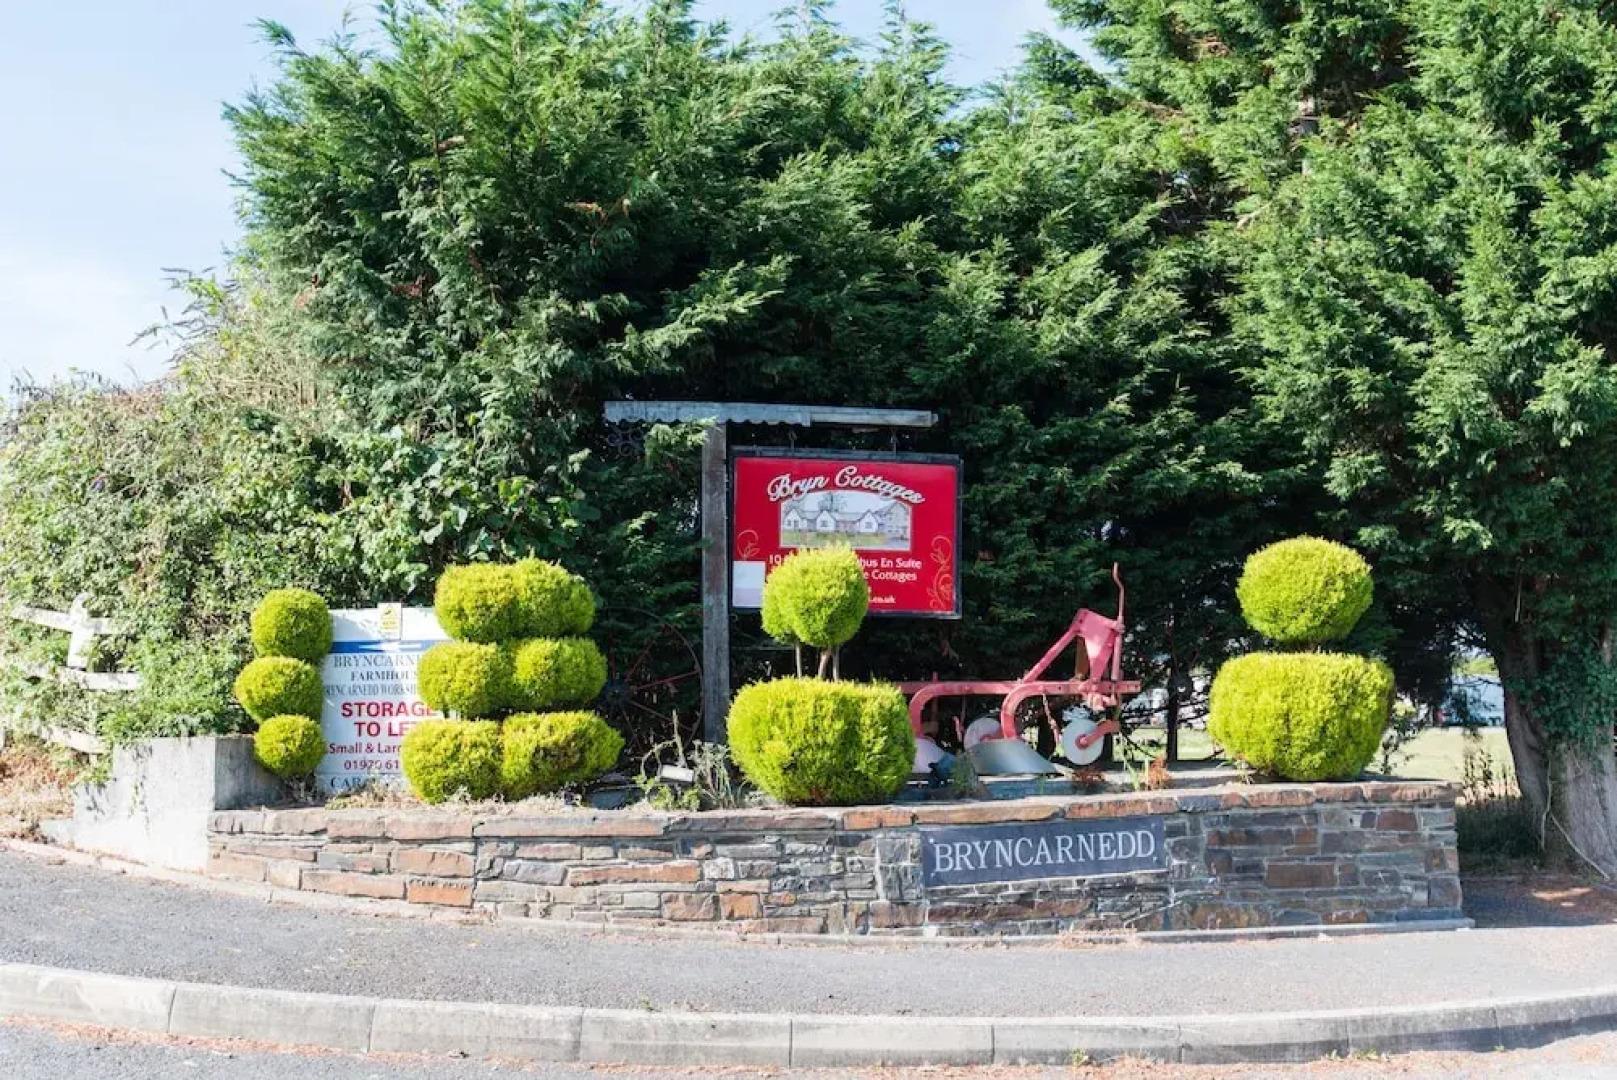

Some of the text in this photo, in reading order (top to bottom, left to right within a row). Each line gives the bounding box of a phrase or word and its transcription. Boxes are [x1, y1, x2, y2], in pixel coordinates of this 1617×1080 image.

[767, 465, 926, 503] Bryn Cottages
[880, 557, 893, 568] En
[895, 557, 922, 569] Suite
[871, 568, 918, 583] Cottages
[381, 684, 417, 695] WORKSH
[353, 721, 381, 737] TO
[329, 742, 363, 754] Small
[365, 742, 374, 754] &
[385, 759, 399, 770] 61
[330, 777, 364, 788] CAR
[933, 830, 1155, 873] BRYNCARNEDD
